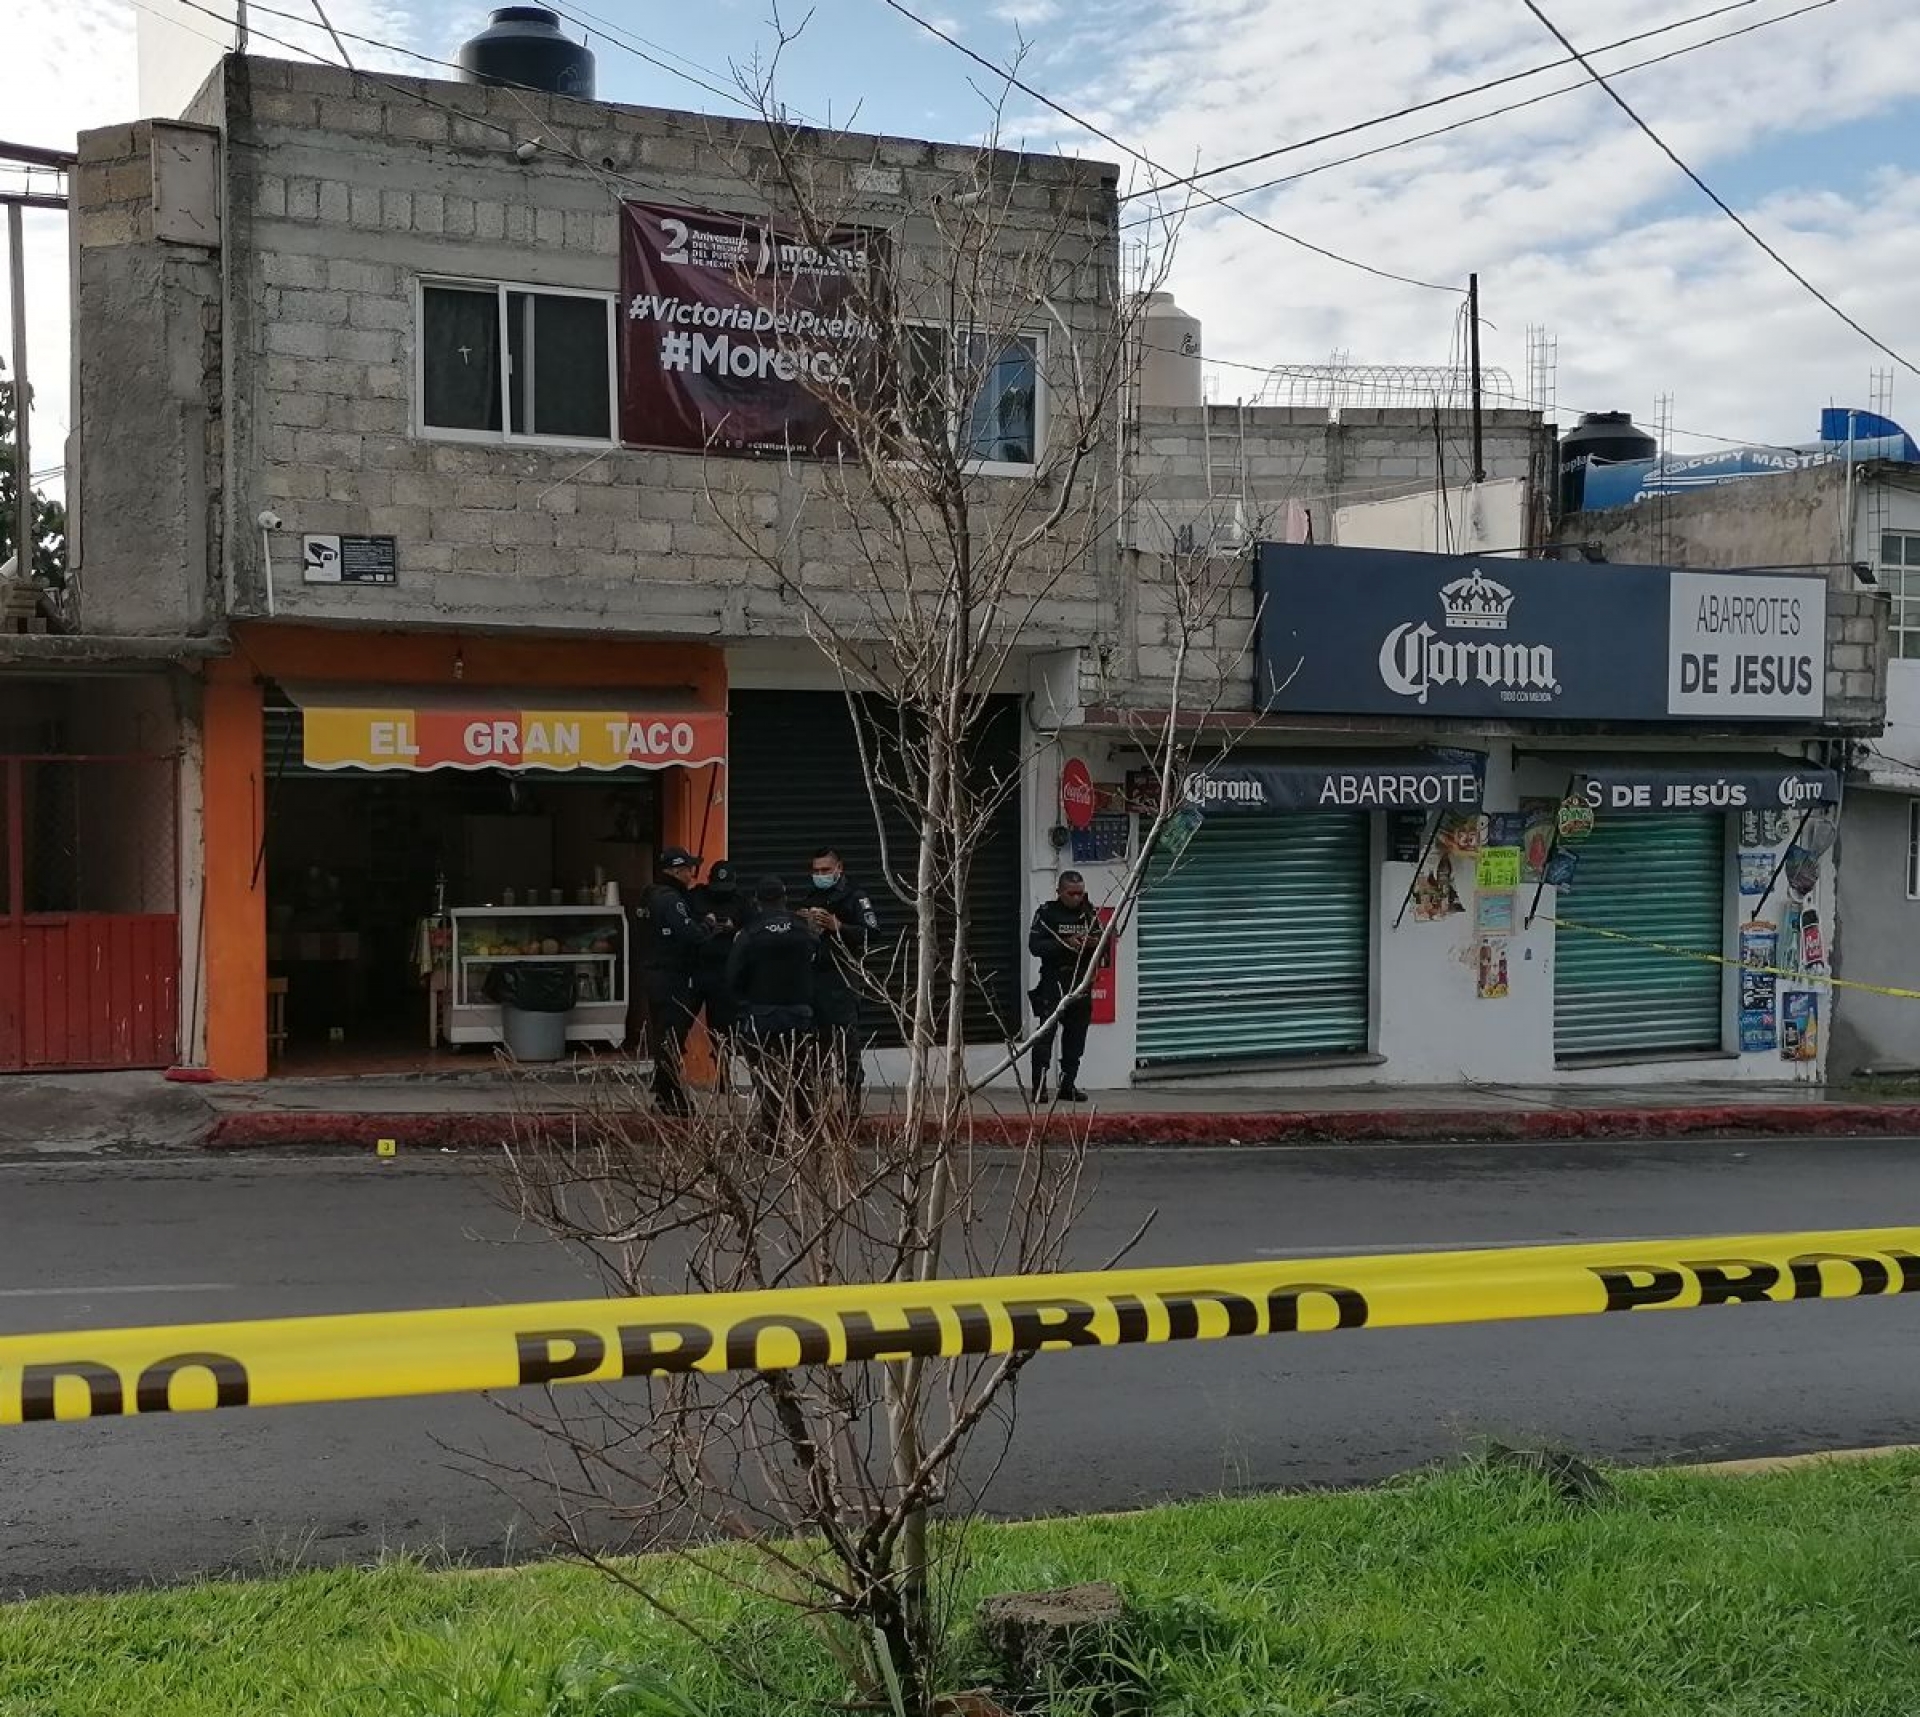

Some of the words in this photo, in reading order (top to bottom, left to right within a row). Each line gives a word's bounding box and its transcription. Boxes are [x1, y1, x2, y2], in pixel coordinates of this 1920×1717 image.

[660, 218, 689, 265] 2
[1687, 450, 1745, 469] COPY
[1696, 594, 1801, 636] ABARROTES
[1379, 620, 1557, 705] Corona
[1680, 652, 1718, 693] DE
[1730, 654, 1812, 695] JESUS
[369, 722, 420, 755] EL
[463, 721, 580, 755] GRAN
[606, 721, 694, 755] TACO
[1183, 771, 1265, 807] Corona
[1612, 785, 1652, 808] DE
[1662, 778, 1748, 807] JESÚS
[515, 1283, 1368, 1385] PROHIBIDO
[22, 1352, 249, 1421] DO
